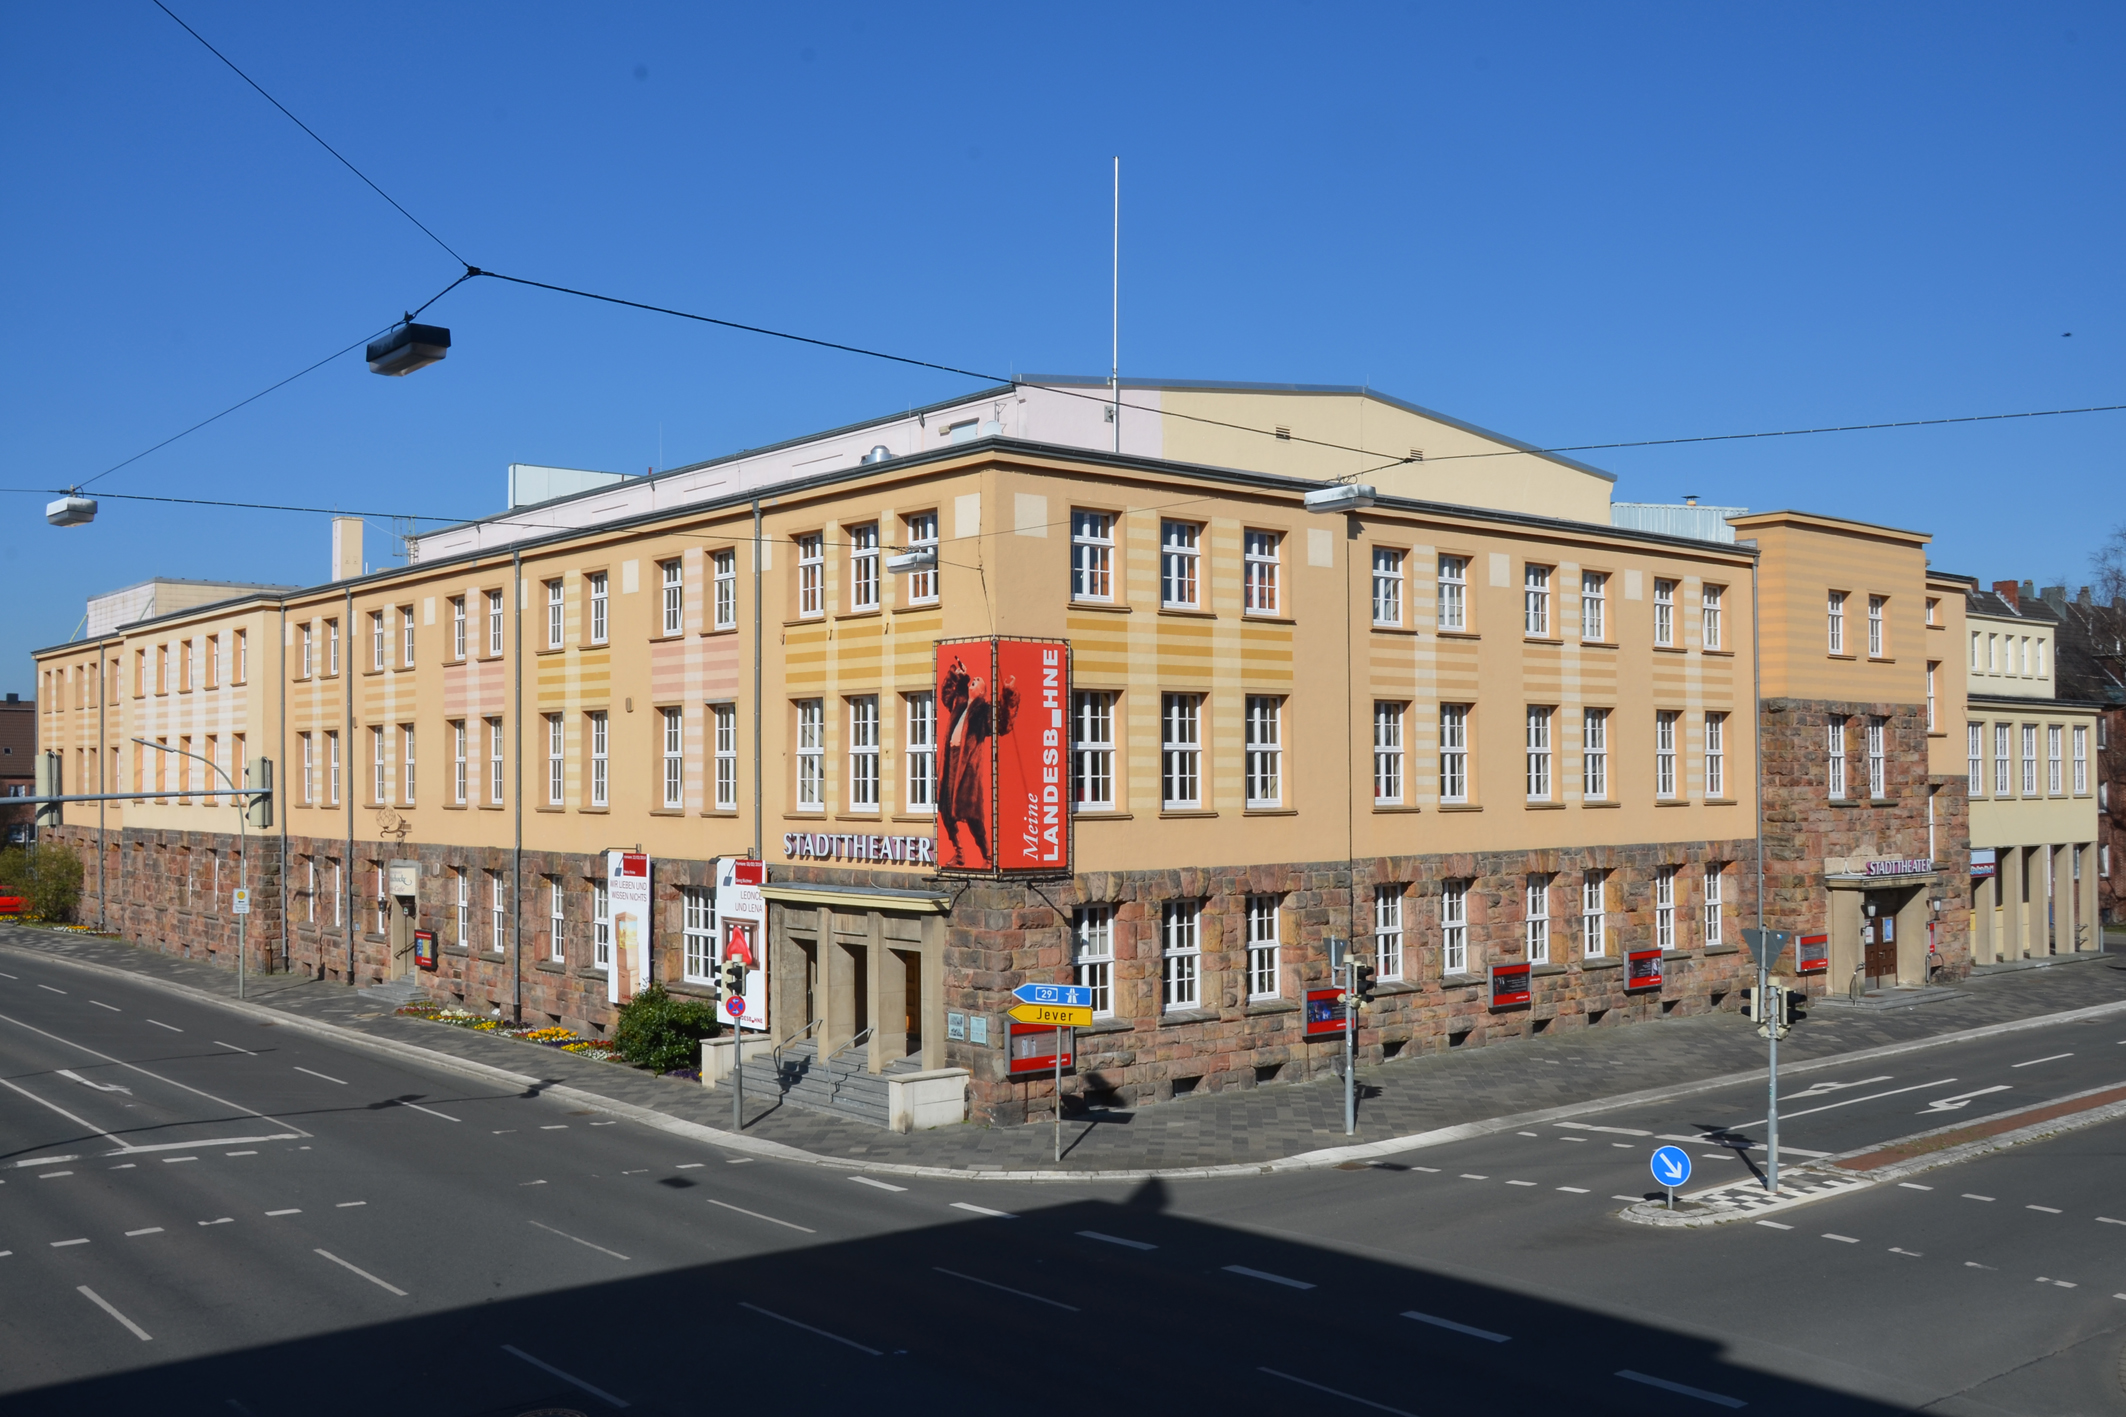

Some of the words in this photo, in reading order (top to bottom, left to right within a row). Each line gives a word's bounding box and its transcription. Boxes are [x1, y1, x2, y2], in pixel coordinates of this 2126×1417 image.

[1023, 793, 1039, 861] Meine
[783, 832, 931, 862] STADTTHEATER
[1868, 858, 1932, 875] STADTTHEATER
[619, 881, 635, 890] LIEBEN
[636, 882, 647, 891] UND
[611, 891, 628, 900] WISSEN
[629, 893, 647, 902] NICHTS
[735, 902, 747, 912] UND
[748, 903, 763, 913] LENA
[1041, 989, 1053, 999] 29
[1036, 1007, 1074, 1022] Jever
